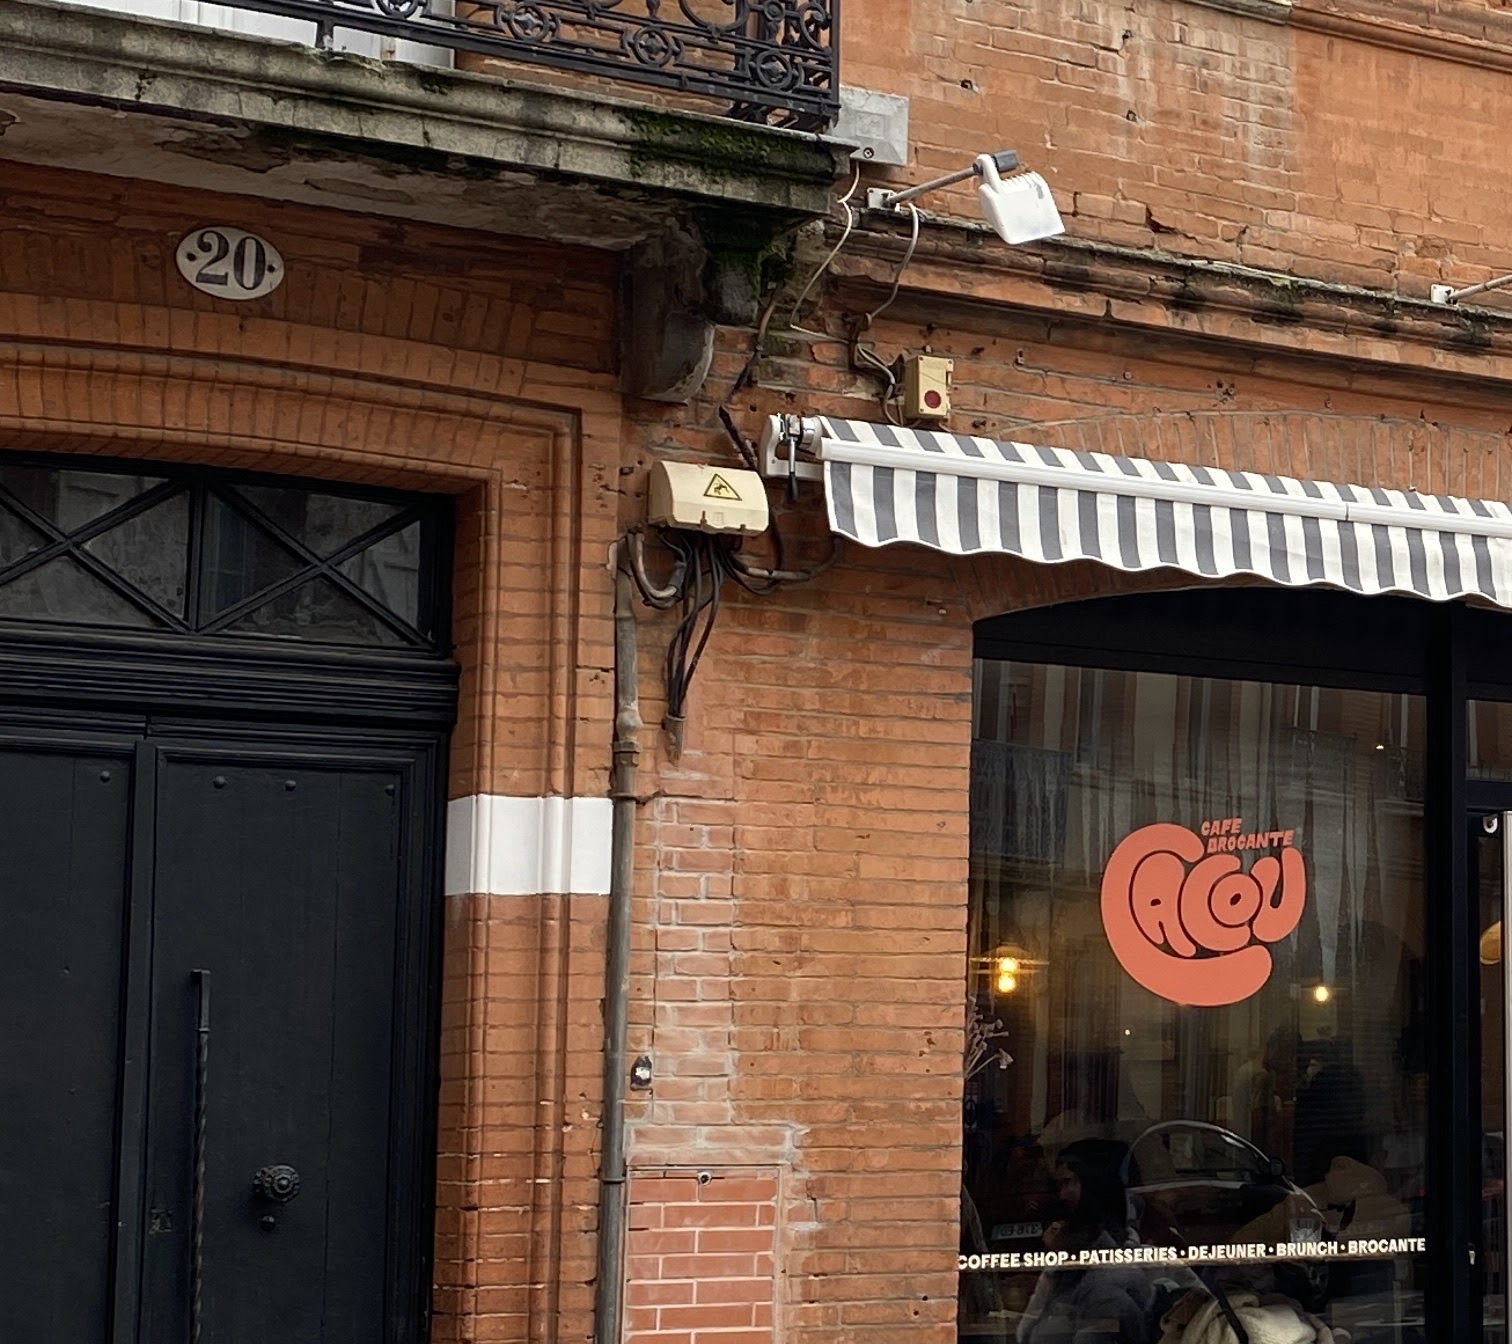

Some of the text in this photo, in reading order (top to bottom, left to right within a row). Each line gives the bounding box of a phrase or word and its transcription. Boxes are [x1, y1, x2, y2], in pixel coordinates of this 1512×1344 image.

[195, 229, 267, 291] 20
[1206, 829, 1295, 854] BROCANTE
[1100, 822, 1307, 1007] CACOU
[957, 1237, 1426, 1271] COFFEE SHOP PATISSERIES DEJEUNER BRUNCH BROCANTE
